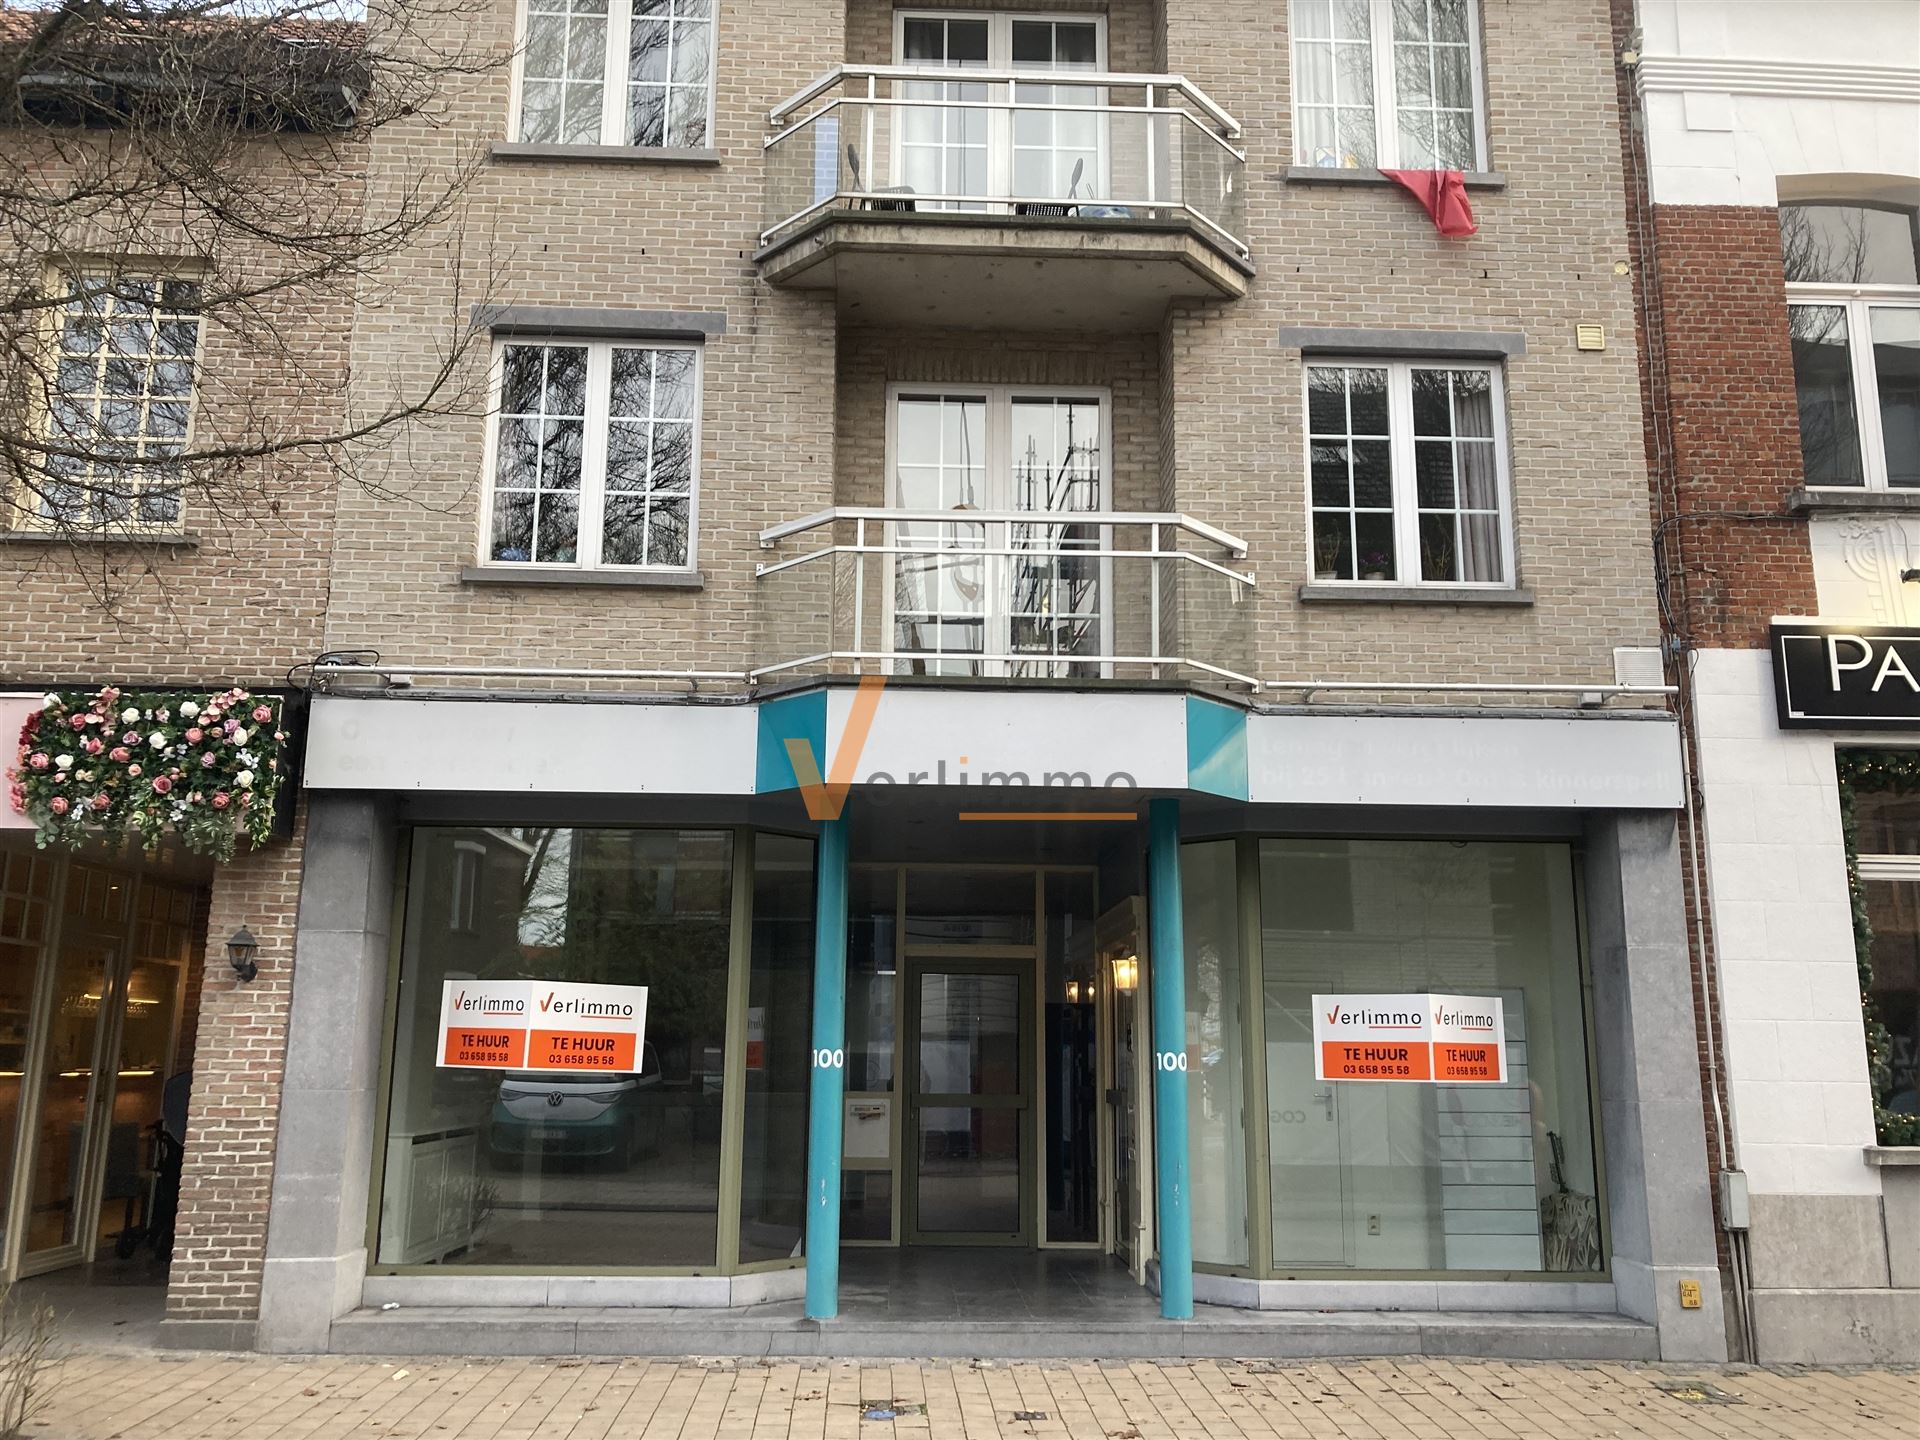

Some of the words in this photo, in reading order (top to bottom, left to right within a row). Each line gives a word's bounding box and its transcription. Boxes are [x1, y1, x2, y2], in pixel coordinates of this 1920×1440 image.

[454, 990, 525, 1012] Verlimmo
[539, 992, 633, 1016] Verlimmo
[1327, 1005, 1422, 1025] Verlimmo
[1434, 1005, 1493, 1027] Verlimmo
[461, 1034, 475, 1047] TE
[476, 1035, 510, 1048] HUUR
[551, 1037, 568, 1050] TE
[572, 1038, 615, 1052] HUUR
[459, 1052, 469, 1061] 03
[470, 1052, 485, 1061] 658
[487, 1052, 497, 1062] 95
[498, 1053, 509, 1062] 58
[549, 1054, 561, 1064] 03
[564, 1054, 584, 1065] 658
[586, 1055, 600, 1065] 95
[602, 1055, 615, 1066] 58
[813, 1048, 844, 1068] 100
[1344, 1048, 1360, 1060] TE
[1365, 1048, 1408, 1061] HUUR
[1446, 1049, 1457, 1062] TE
[1459, 1049, 1486, 1062] HUUR
[1157, 1052, 1188, 1072] 100
[1343, 1065, 1356, 1074] 03
[1359, 1065, 1378, 1074] 658
[1381, 1065, 1394, 1074] 95
[1397, 1065, 1410, 1075] 58
[1446, 1066, 1455, 1075] 03
[1456, 1066, 1469, 1075] 658
[1470, 1066, 1478, 1075] 95
[1479, 1066, 1488, 1076] 58
